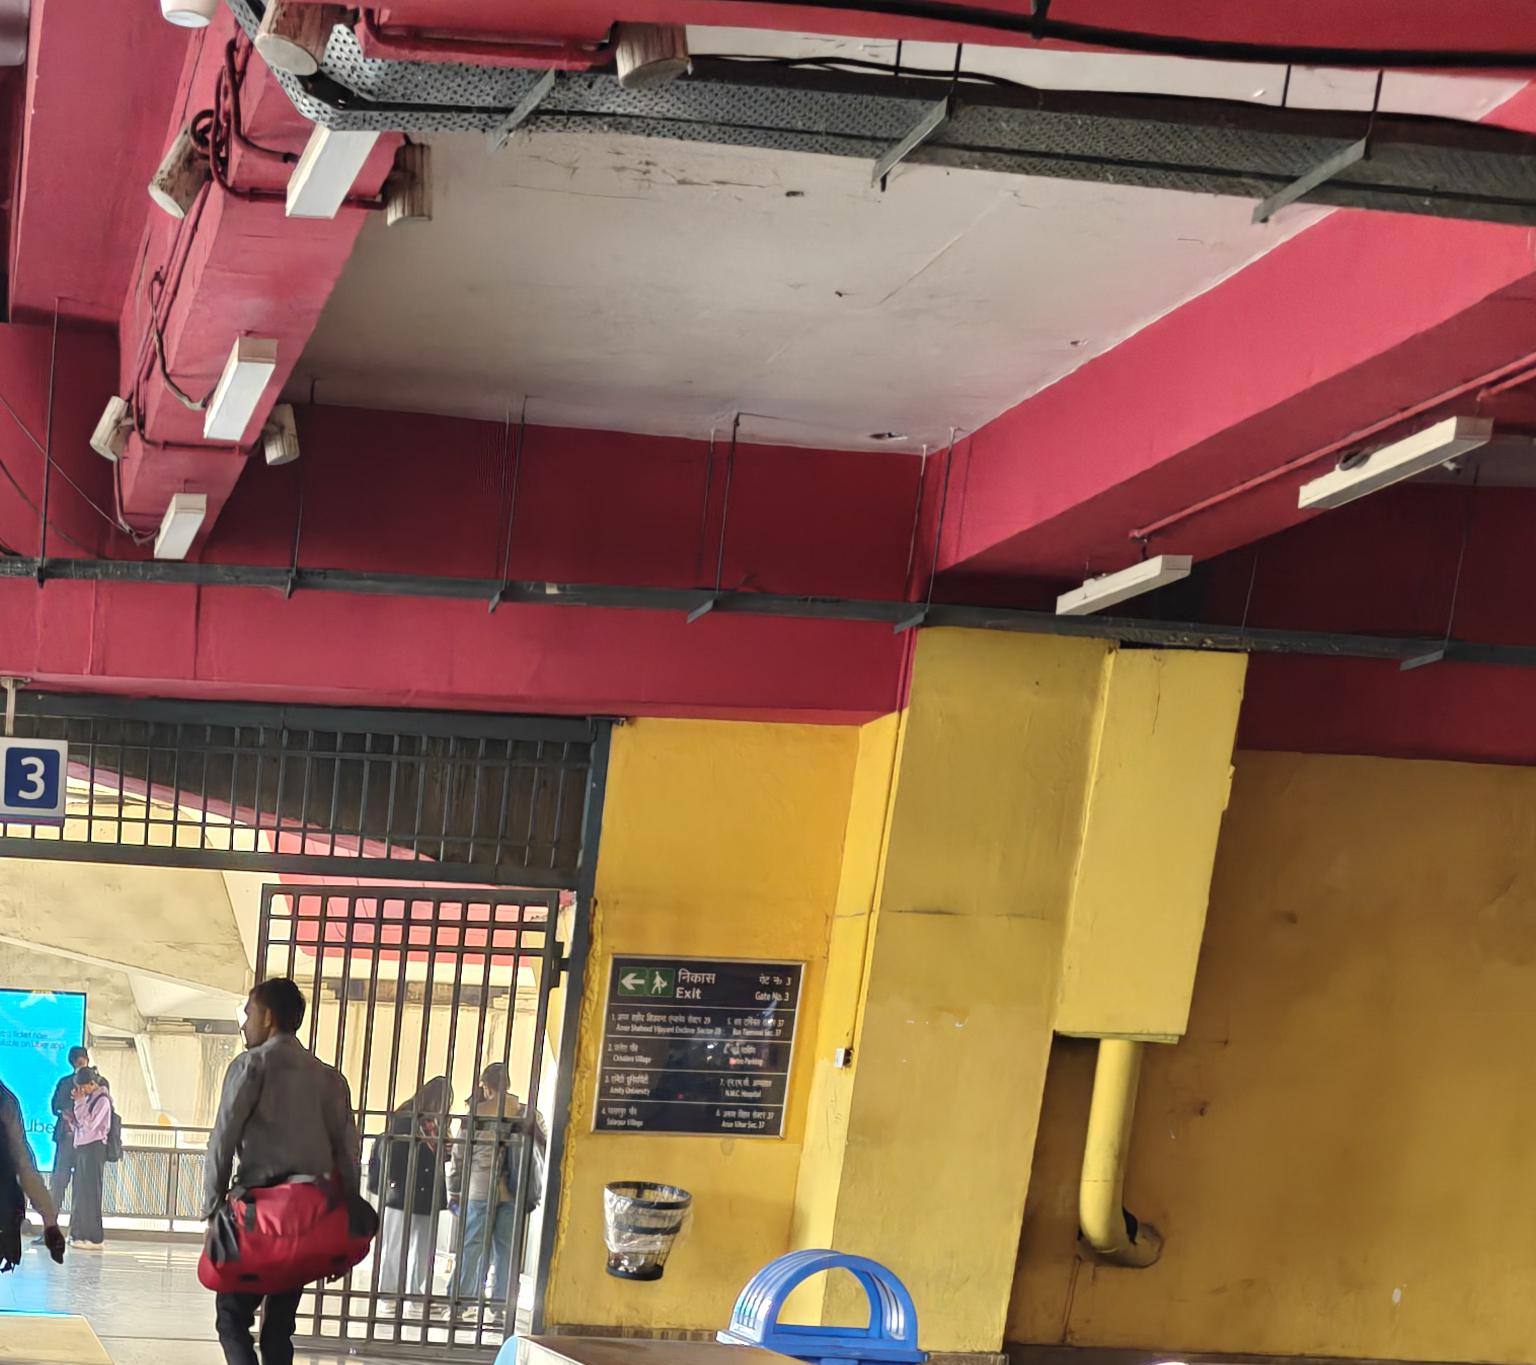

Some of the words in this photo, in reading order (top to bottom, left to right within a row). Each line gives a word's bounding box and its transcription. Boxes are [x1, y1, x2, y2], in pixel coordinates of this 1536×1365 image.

[17, 756, 46, 800] 3
[678, 968, 716, 984] निकास
[675, 987, 702, 999] Exit
[755, 991, 771, 1001] Gate
